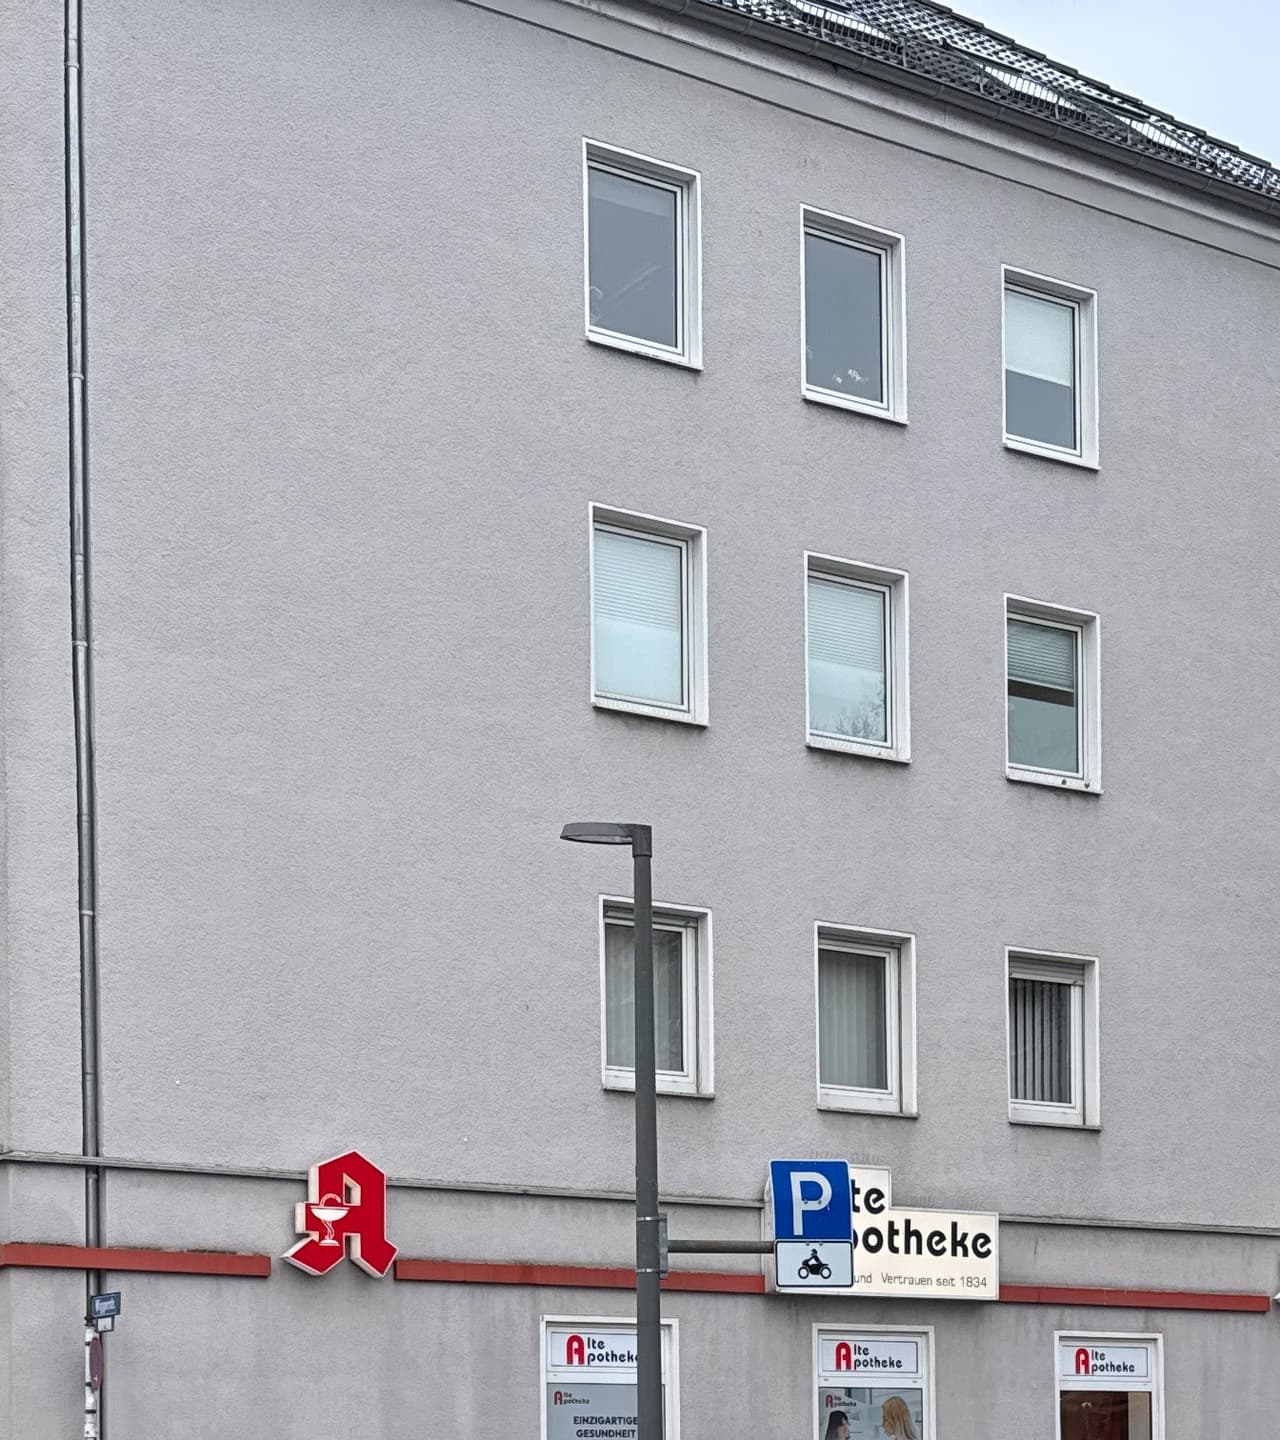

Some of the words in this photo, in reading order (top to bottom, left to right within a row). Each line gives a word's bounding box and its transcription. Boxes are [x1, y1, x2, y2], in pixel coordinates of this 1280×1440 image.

[790, 1171, 833, 1236] P
[851, 1179, 886, 1215] te
[854, 1218, 992, 1259] otheke
[881, 1272, 933, 1287] Vertrauen
[936, 1276, 956, 1287] seit
[961, 1276, 988, 1288] 1834
[573, 1416, 639, 1425] EINZIGARTIGE
[575, 1429, 637, 1438] GESUNDHEIT
